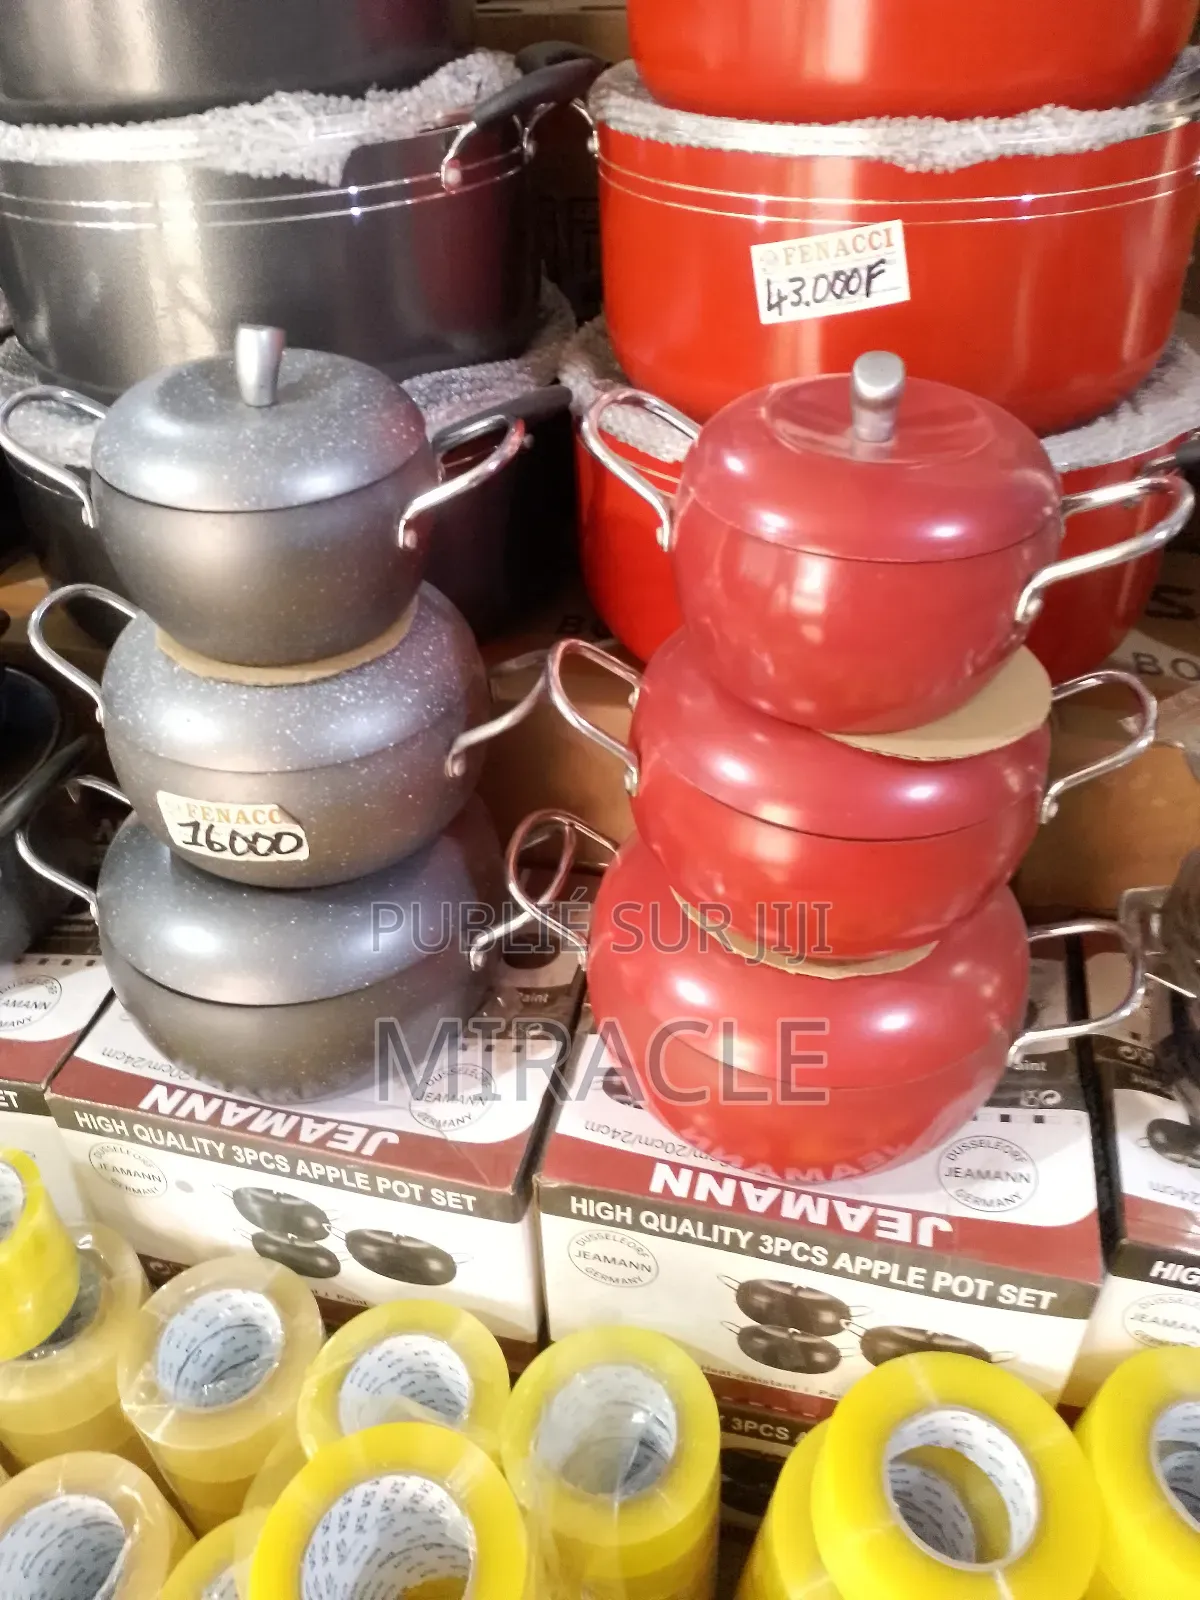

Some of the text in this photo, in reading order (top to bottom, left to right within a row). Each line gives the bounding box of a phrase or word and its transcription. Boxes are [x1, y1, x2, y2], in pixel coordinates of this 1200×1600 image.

[783, 227, 895, 266] FENACCI
[766, 258, 887, 316] 43.000F
[177, 820, 304, 857] 16000
[138, 1083, 401, 1158] JEAMANN
[74, 1110, 477, 1212] HIGH QUALITY 3PCS APPLE POT SET
[944, 1167, 1031, 1184] JEAMANN
[649, 1161, 953, 1248] JEAMANN
[570, 1195, 1058, 1311] HIGH QUALITY 3PCS APPLE POT SET
[574, 1250, 652, 1273] JEAMANN
[731, 1417, 790, 1441] 3PCS
